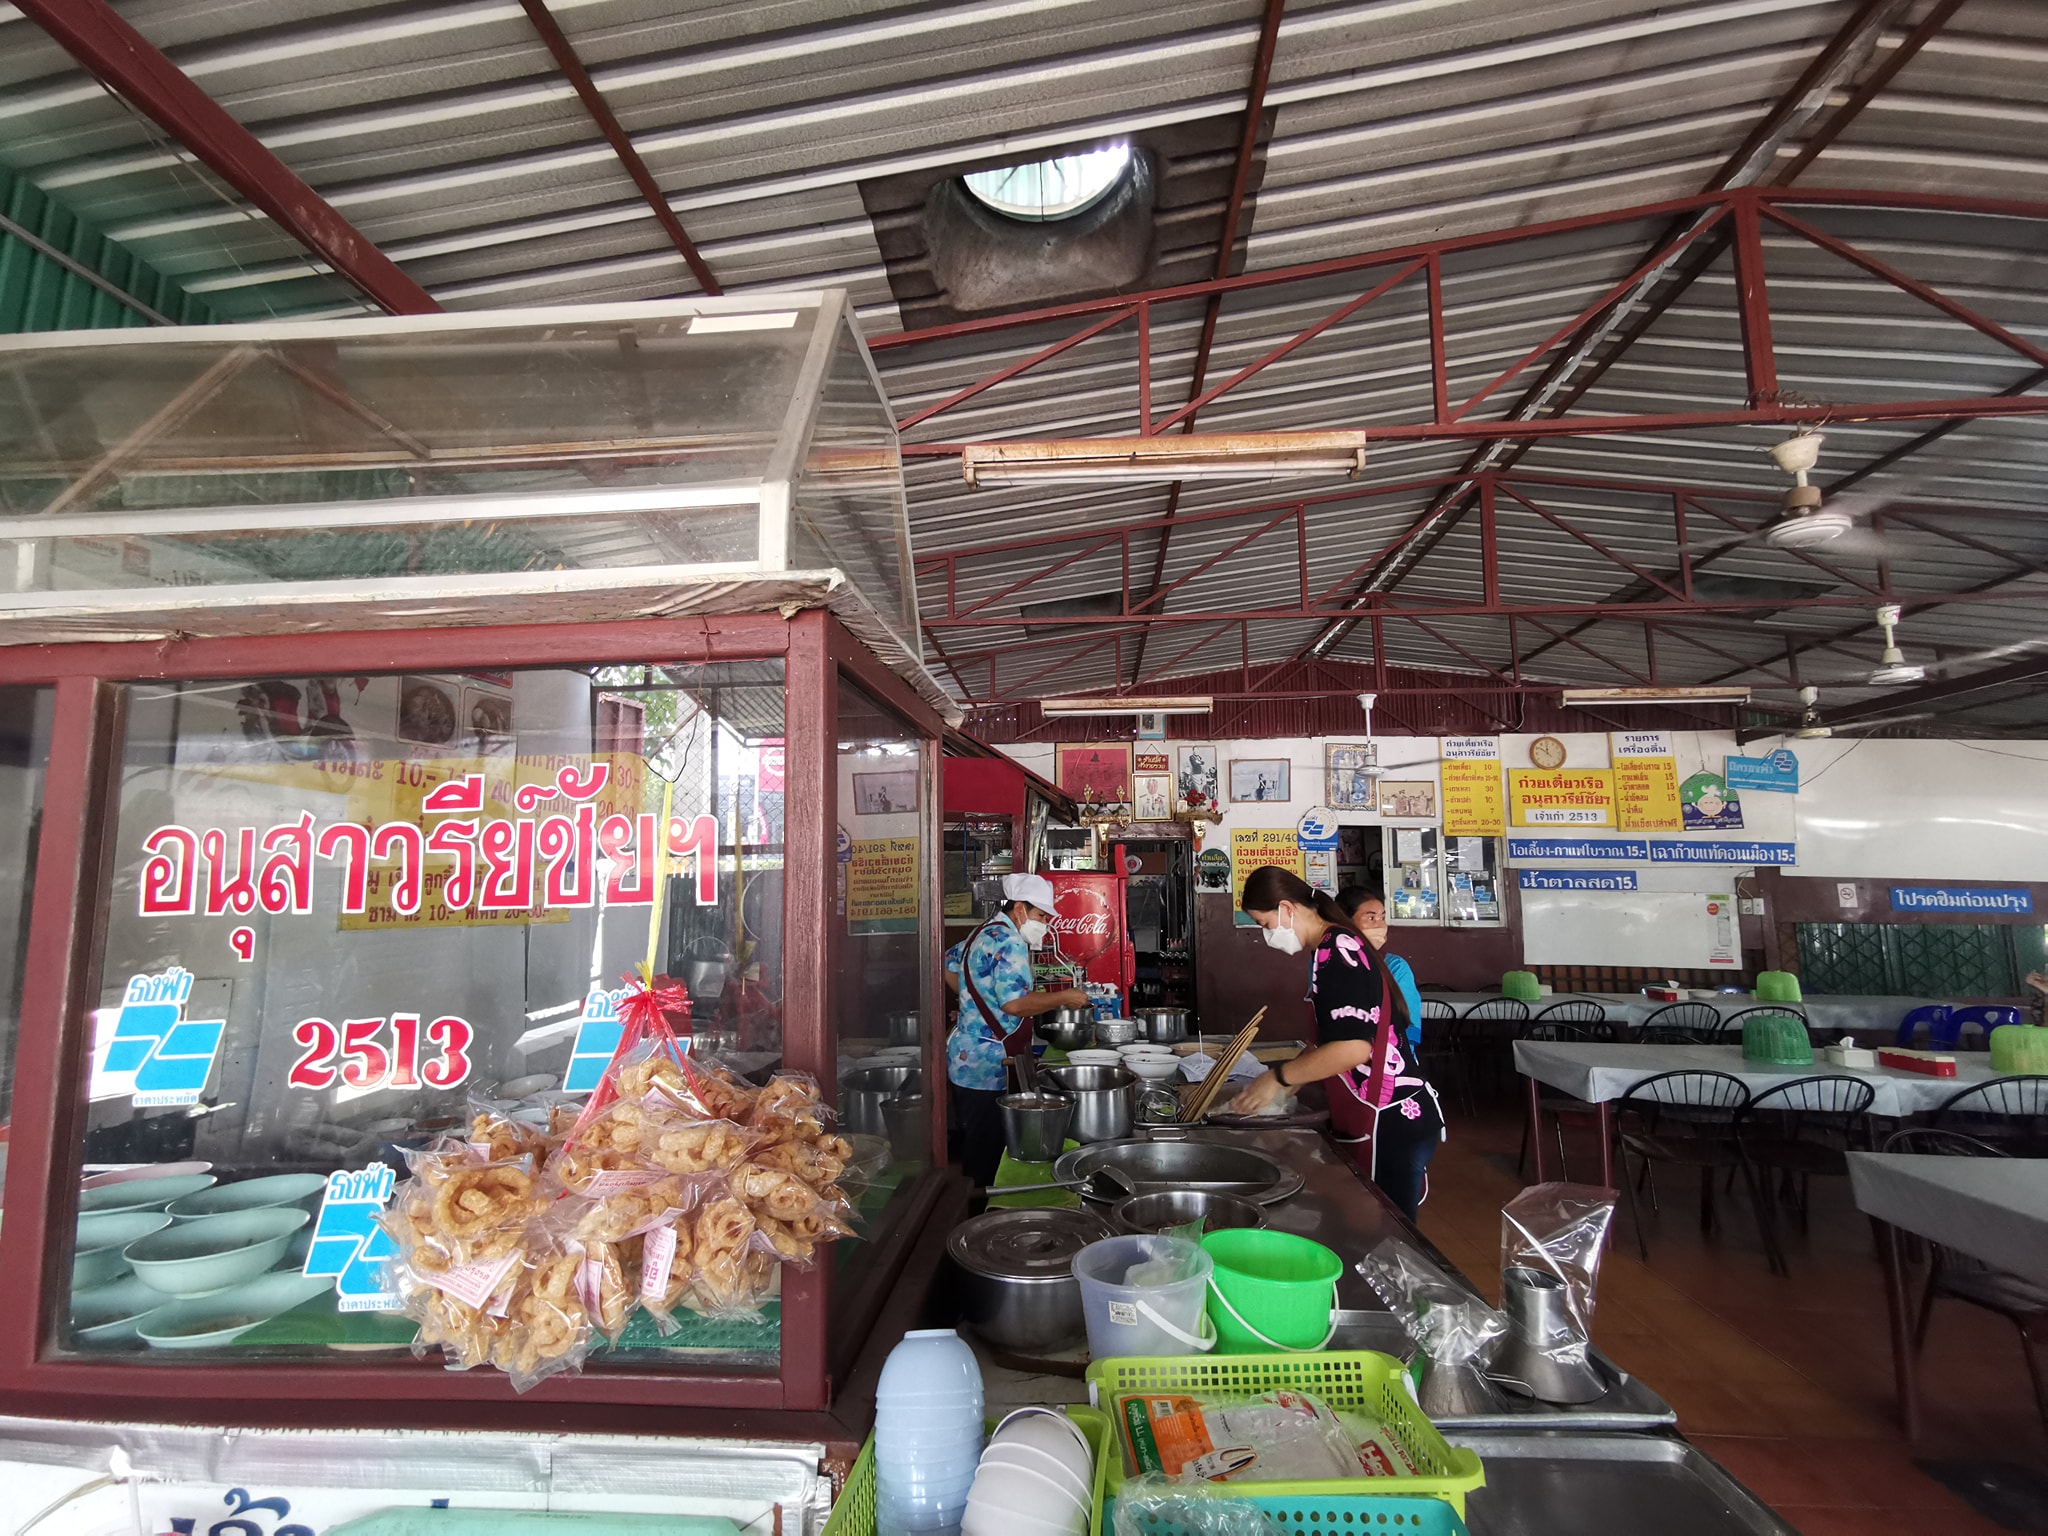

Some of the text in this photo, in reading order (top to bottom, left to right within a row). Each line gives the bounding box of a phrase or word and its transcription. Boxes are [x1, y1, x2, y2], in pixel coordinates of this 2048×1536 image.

[1665, 773, 1674, 781] 15
[1666, 783, 1675, 791] 15
[1521, 791, 1611, 808] อนุสาวรีย์ชัยฯ
[1535, 810, 1598, 822] เจ้าเก่า 2513
[1235, 829, 1298, 843] เลขที่ 291/40
[1626, 846, 1646, 857] 15.-
[1776, 849, 1795, 862] 15.-
[140, 763, 719, 962] อนุสาวรีย์ชัยฯ
[1896, 889, 2028, 912] โปรดชิมก่อนปรุง
[129, 967, 193, 1003] ธงฟ้า
[288, 1012, 474, 1090] 2513
[329, 1163, 395, 1201] ธงฟ้า
